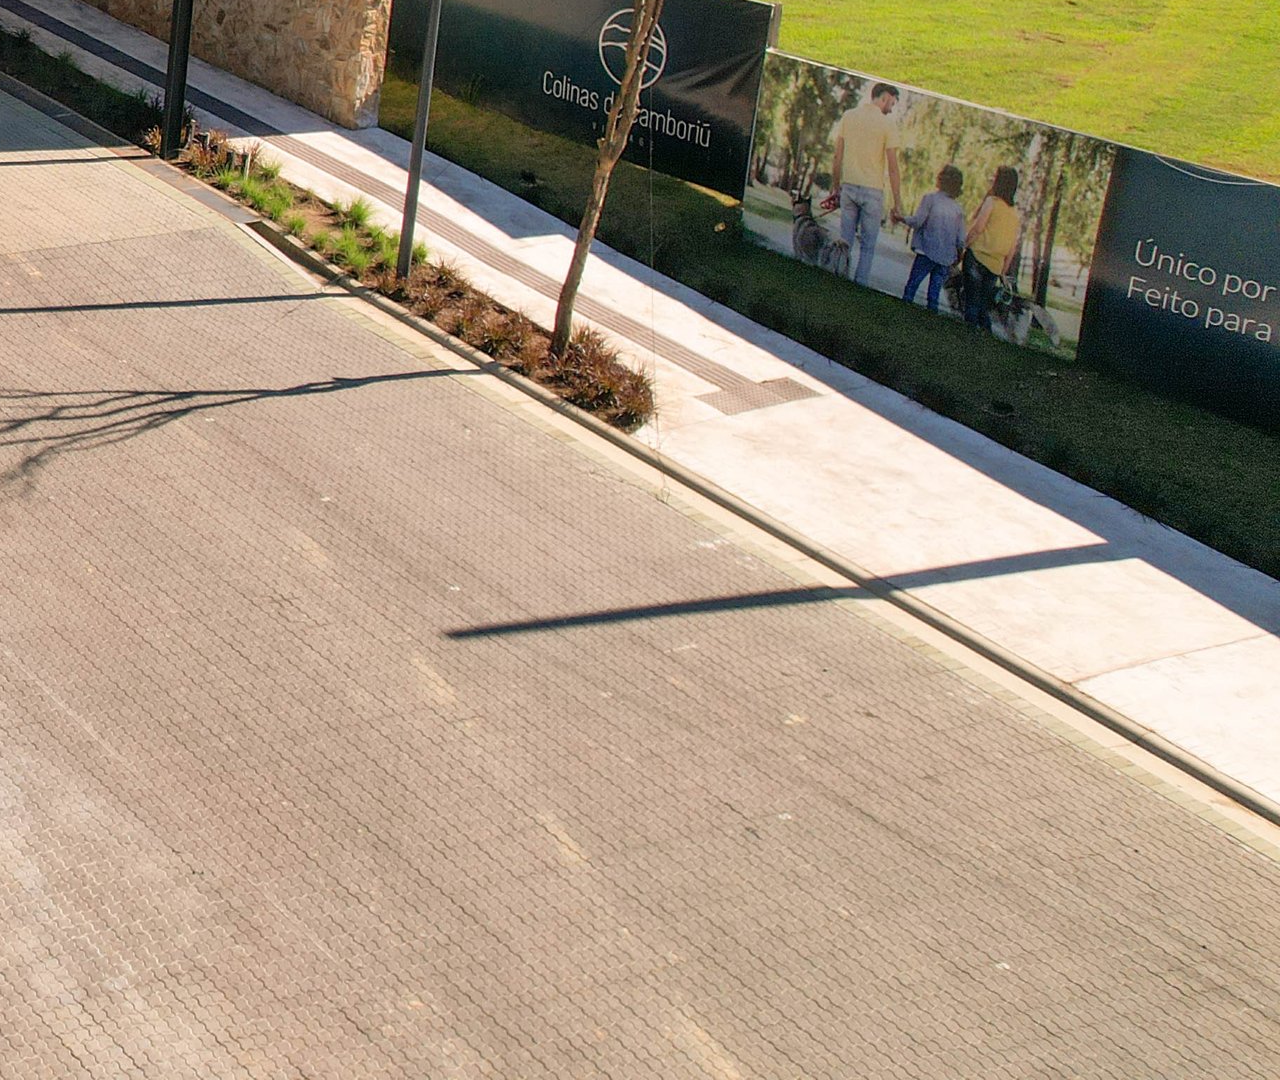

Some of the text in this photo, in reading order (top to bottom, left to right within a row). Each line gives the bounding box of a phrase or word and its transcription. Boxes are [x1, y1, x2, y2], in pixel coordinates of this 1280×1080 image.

[542, 70, 599, 110] Colinas
[631, 108, 712, 148] amboriú
[1134, 238, 1277, 302] Único por
[1127, 275, 1272, 342] Feito para
